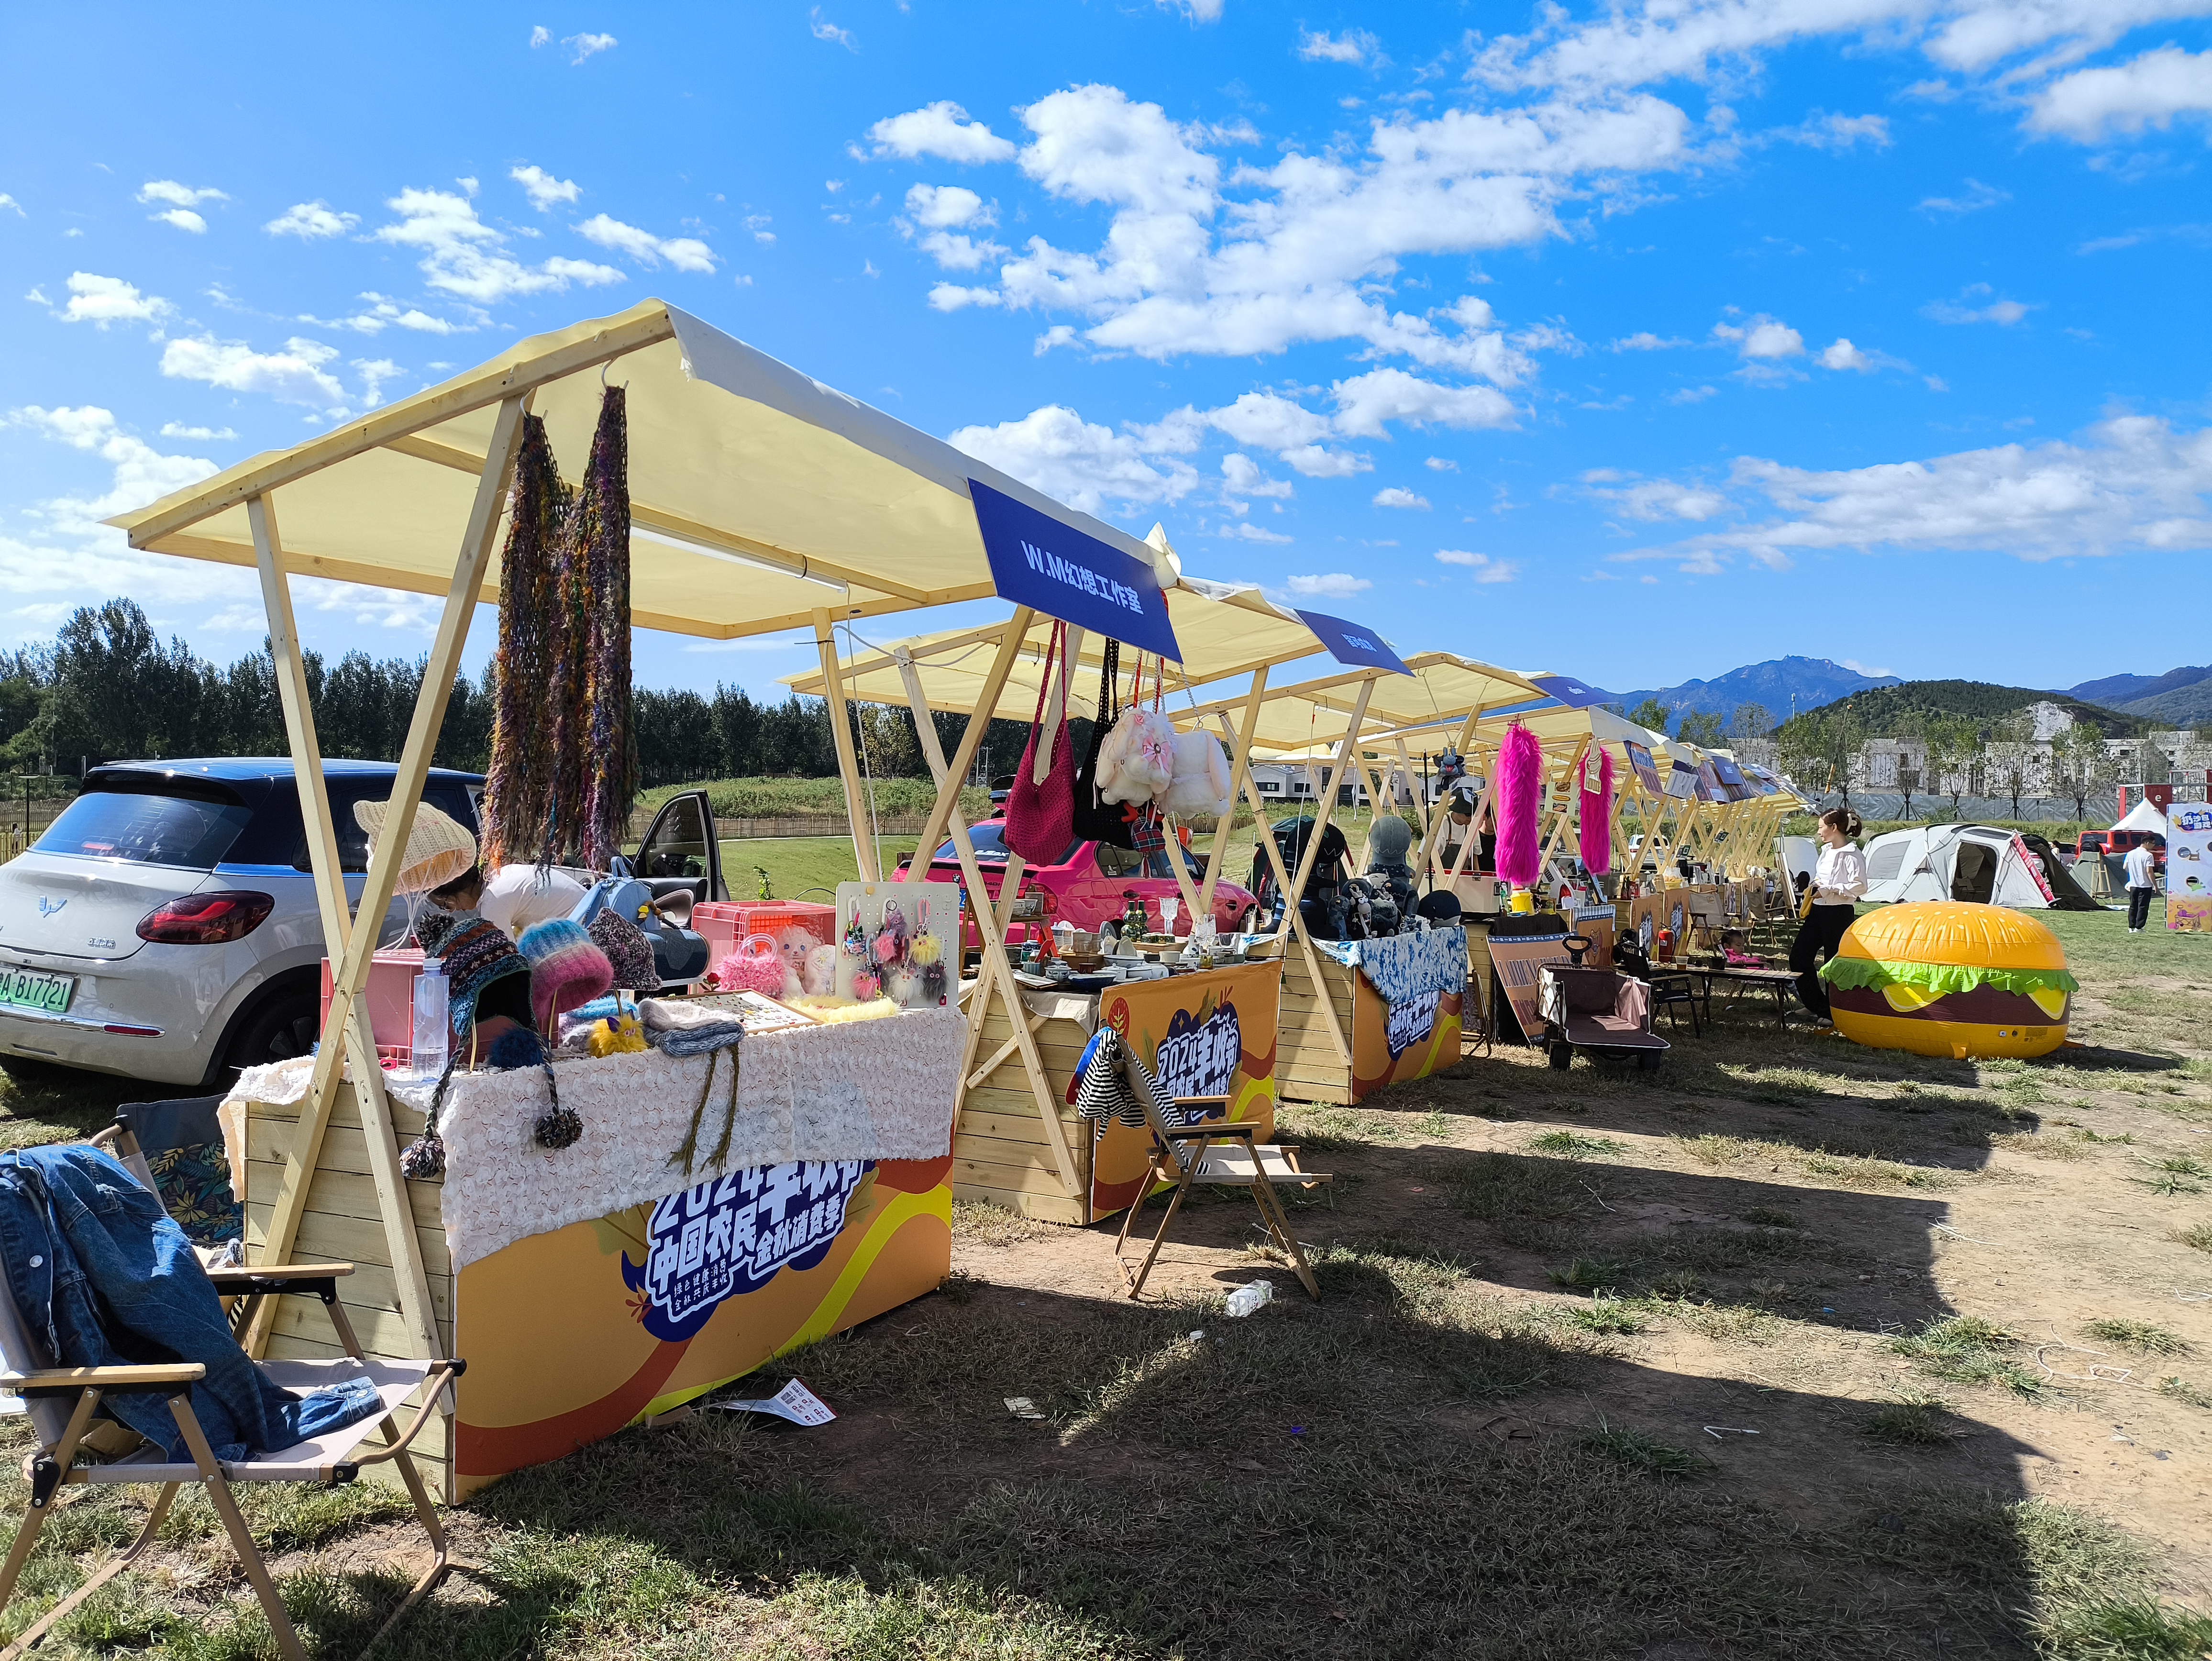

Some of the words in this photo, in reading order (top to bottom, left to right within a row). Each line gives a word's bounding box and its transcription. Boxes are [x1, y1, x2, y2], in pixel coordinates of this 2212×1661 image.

[1020, 539, 1144, 615] W.M幻想工作室
[15, 975, 67, 1005] B17721
[1158, 1023, 1236, 1089] 2024丰收节
[653, 1201, 757, 1295] 中国农民
[754, 1192, 841, 1269] 金秋消费季
[674, 1258, 726, 1298] 绿色健康消费
[675, 1273, 728, 1311] 金秋共庆丰收
